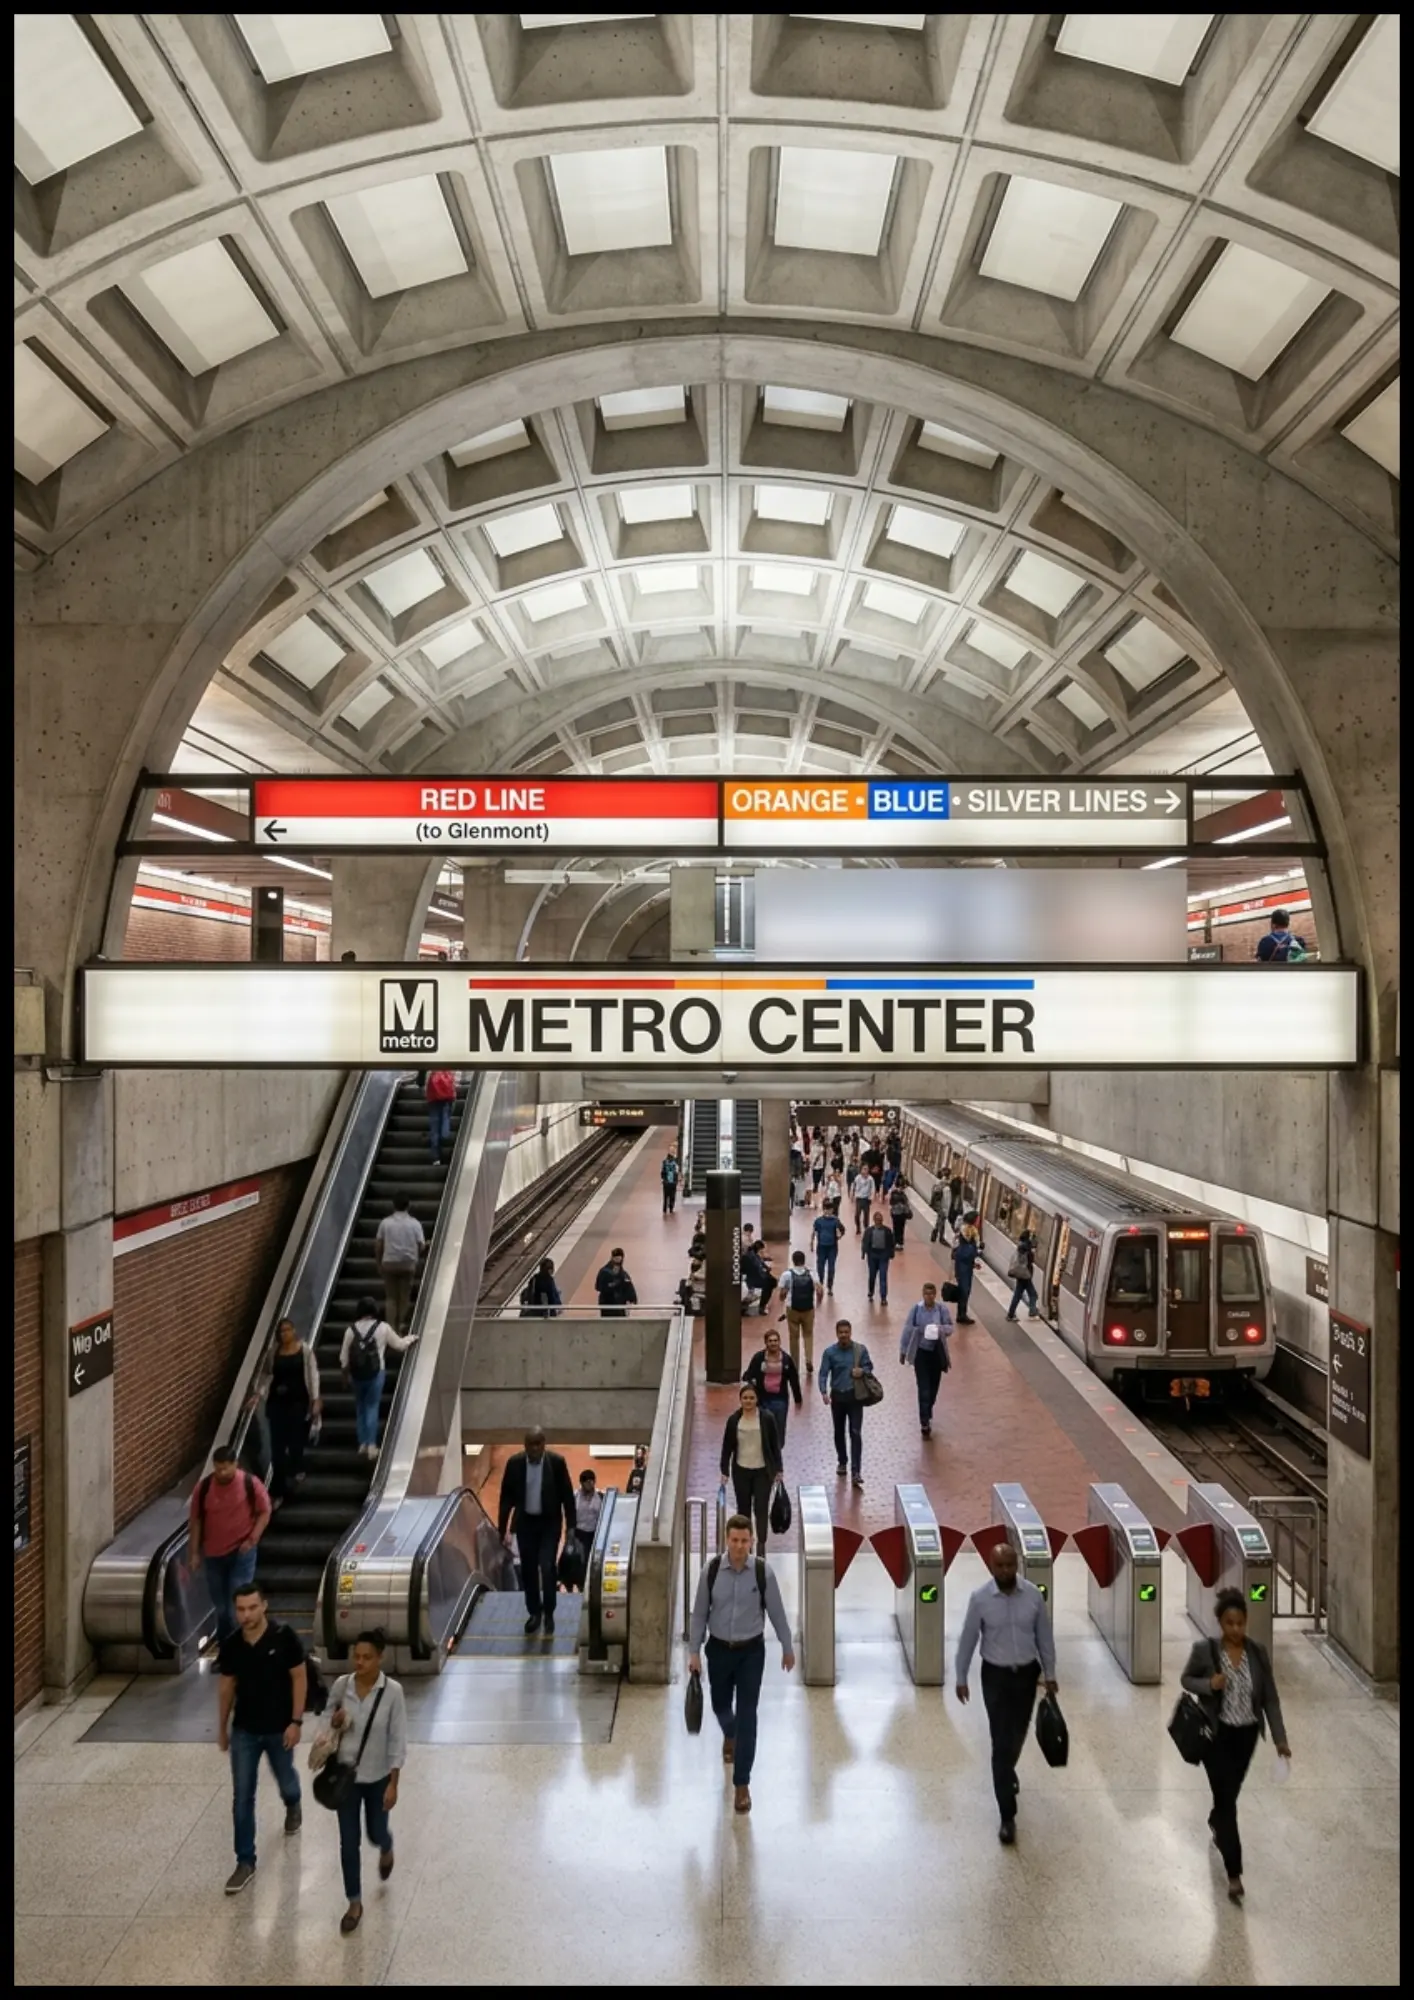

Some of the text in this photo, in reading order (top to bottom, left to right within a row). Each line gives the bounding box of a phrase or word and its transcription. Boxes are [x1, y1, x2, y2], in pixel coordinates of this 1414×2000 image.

[421, 788, 545, 811] RED LINE
[731, 789, 1147, 813] ORANGE BLUE SILVER LINES
[416, 822, 549, 842] (to Glenmont)
[384, 983, 434, 1031] M
[469, 997, 1035, 1054] METRO CENTER
[382, 1033, 436, 1049] metro
